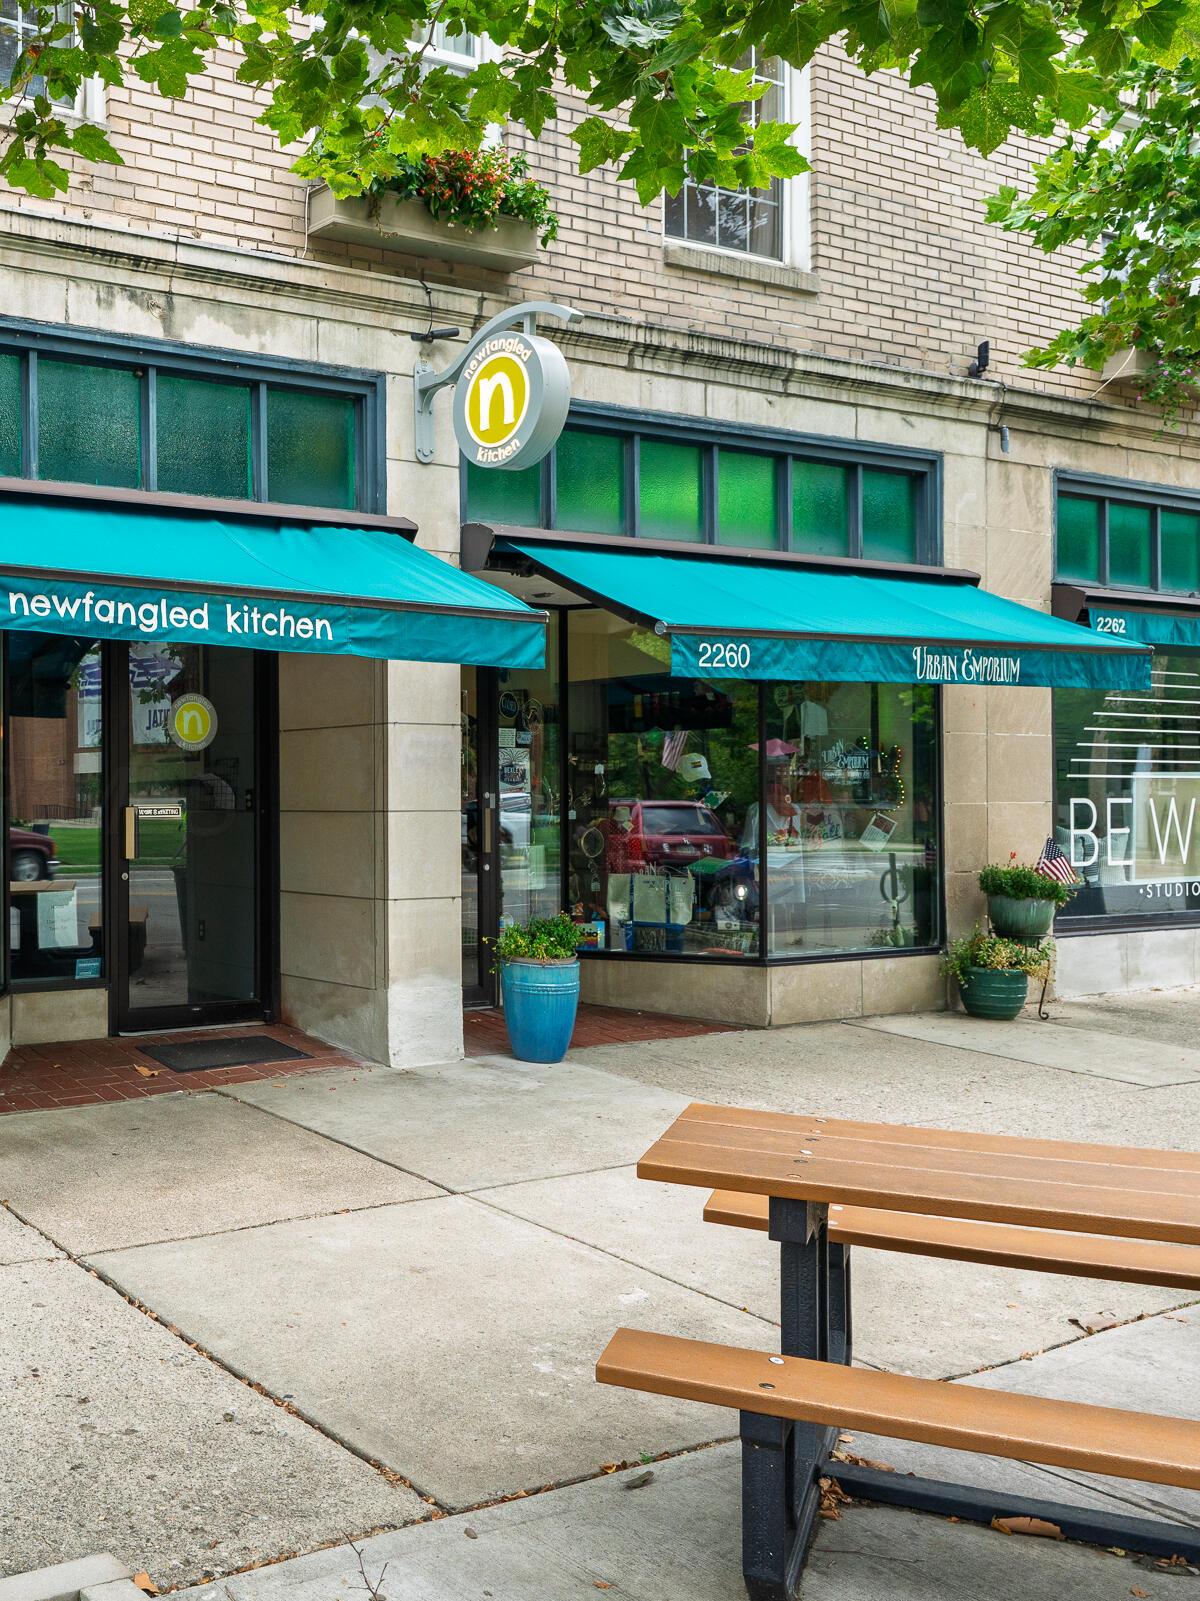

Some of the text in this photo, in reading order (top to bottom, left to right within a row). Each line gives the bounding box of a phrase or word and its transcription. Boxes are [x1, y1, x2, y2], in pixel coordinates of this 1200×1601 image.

[464, 337, 532, 380] newfangled
[479, 371, 515, 431] n
[476, 438, 520, 462] kitchen
[8, 591, 334, 641] newfangled kitchen
[1097, 616, 1126, 634] 2262
[699, 643, 750, 668] 2260
[1146, 882, 1200, 899] STUDIO
